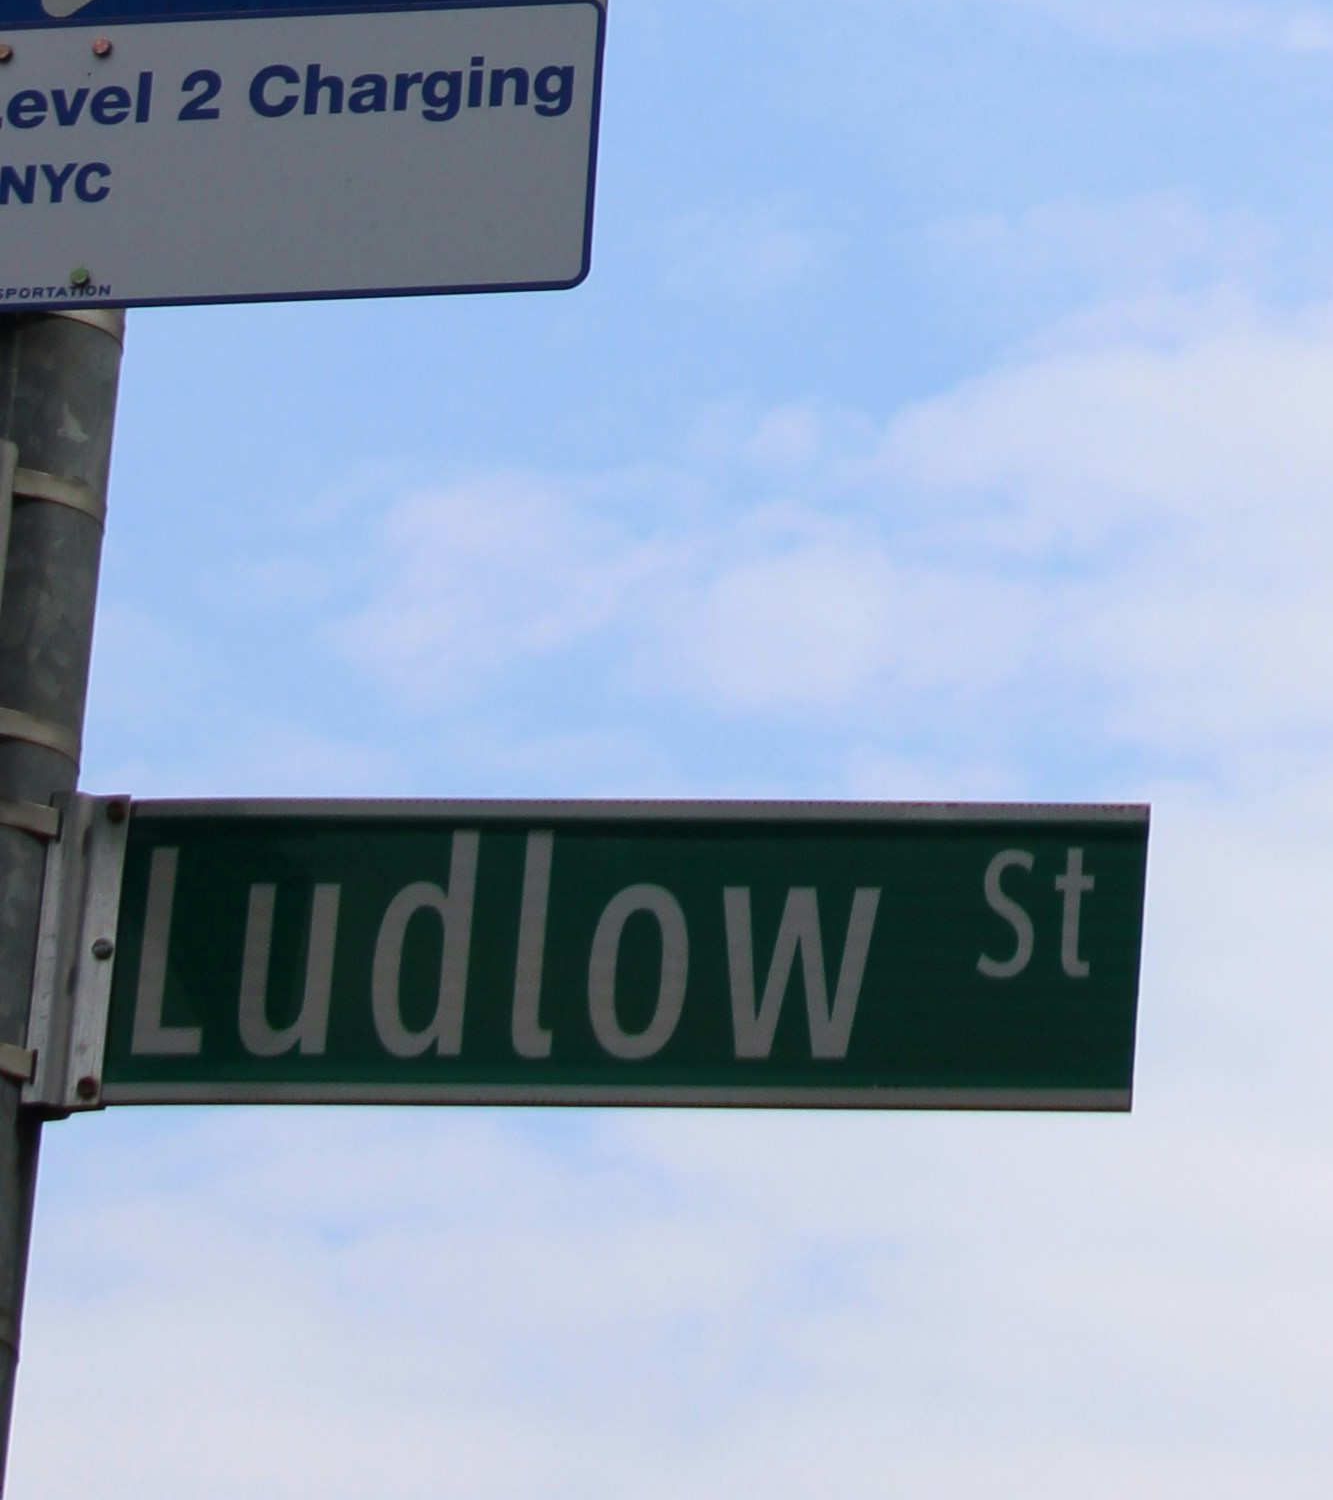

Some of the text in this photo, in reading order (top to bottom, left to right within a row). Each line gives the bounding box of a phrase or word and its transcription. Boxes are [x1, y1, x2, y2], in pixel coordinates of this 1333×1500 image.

[0, 56, 575, 129] evel 2 Charging
[0, 162, 112, 205] NYC
[131, 830, 1095, 1059] Ludlow St
